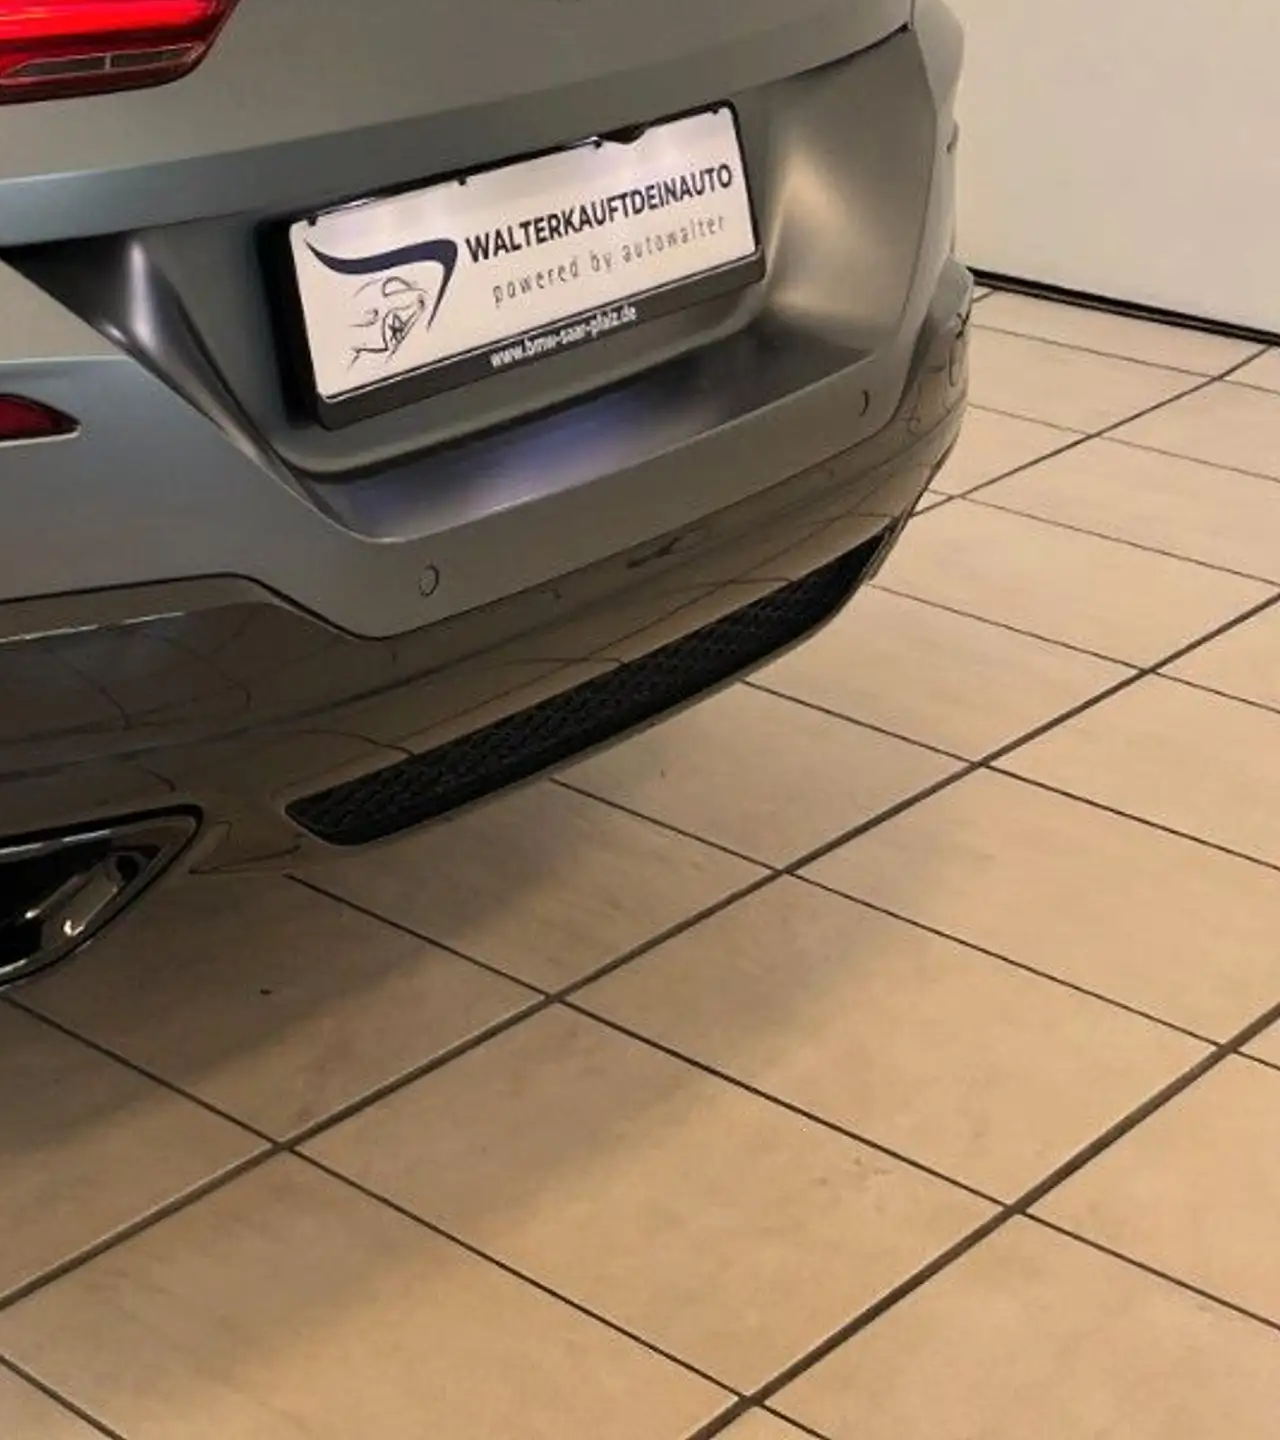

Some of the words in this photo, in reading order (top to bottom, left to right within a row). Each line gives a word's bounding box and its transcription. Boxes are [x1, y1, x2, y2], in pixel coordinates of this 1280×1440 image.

[465, 163, 733, 263] WALTERKAUFTDEINAUTO
[493, 257, 579, 309] powered
[590, 250, 613, 276] by
[622, 214, 726, 264] autowalter
